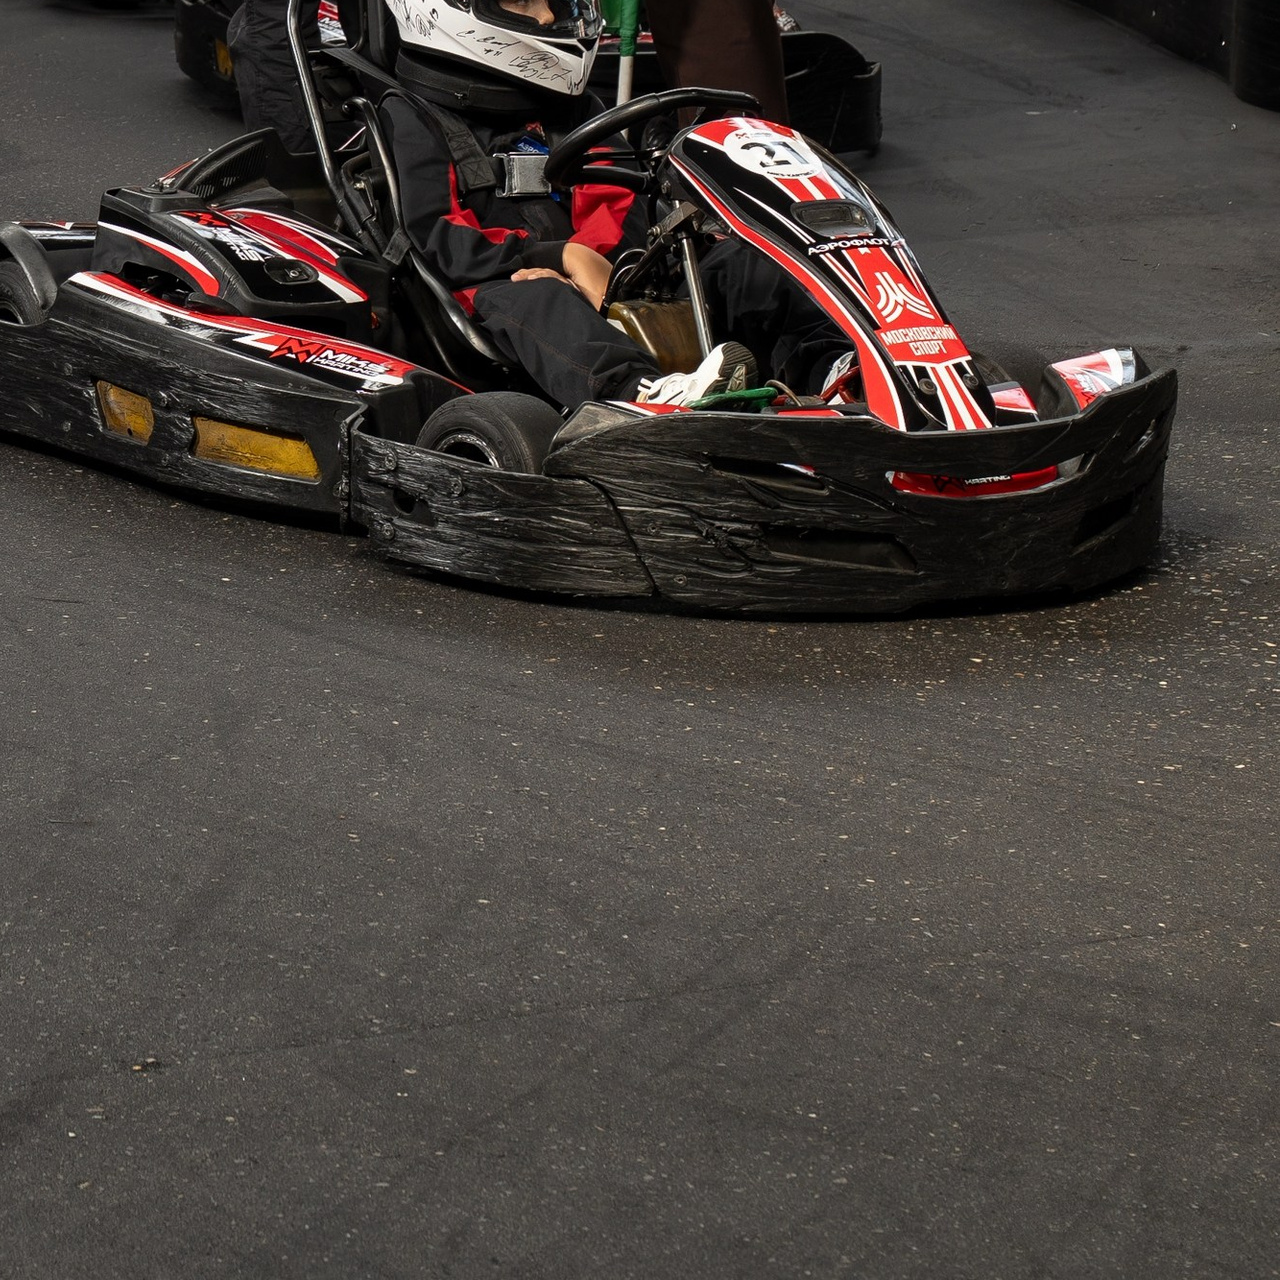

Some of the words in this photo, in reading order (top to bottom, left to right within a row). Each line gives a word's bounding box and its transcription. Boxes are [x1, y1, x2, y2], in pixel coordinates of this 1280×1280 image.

[740, 141, 810, 168] 21
[808, 238, 891, 256] АЭРОФЛОТ
[880, 324, 958, 346] МОСКОВСКИЙ
[909, 340, 947, 356] СПОРТ
